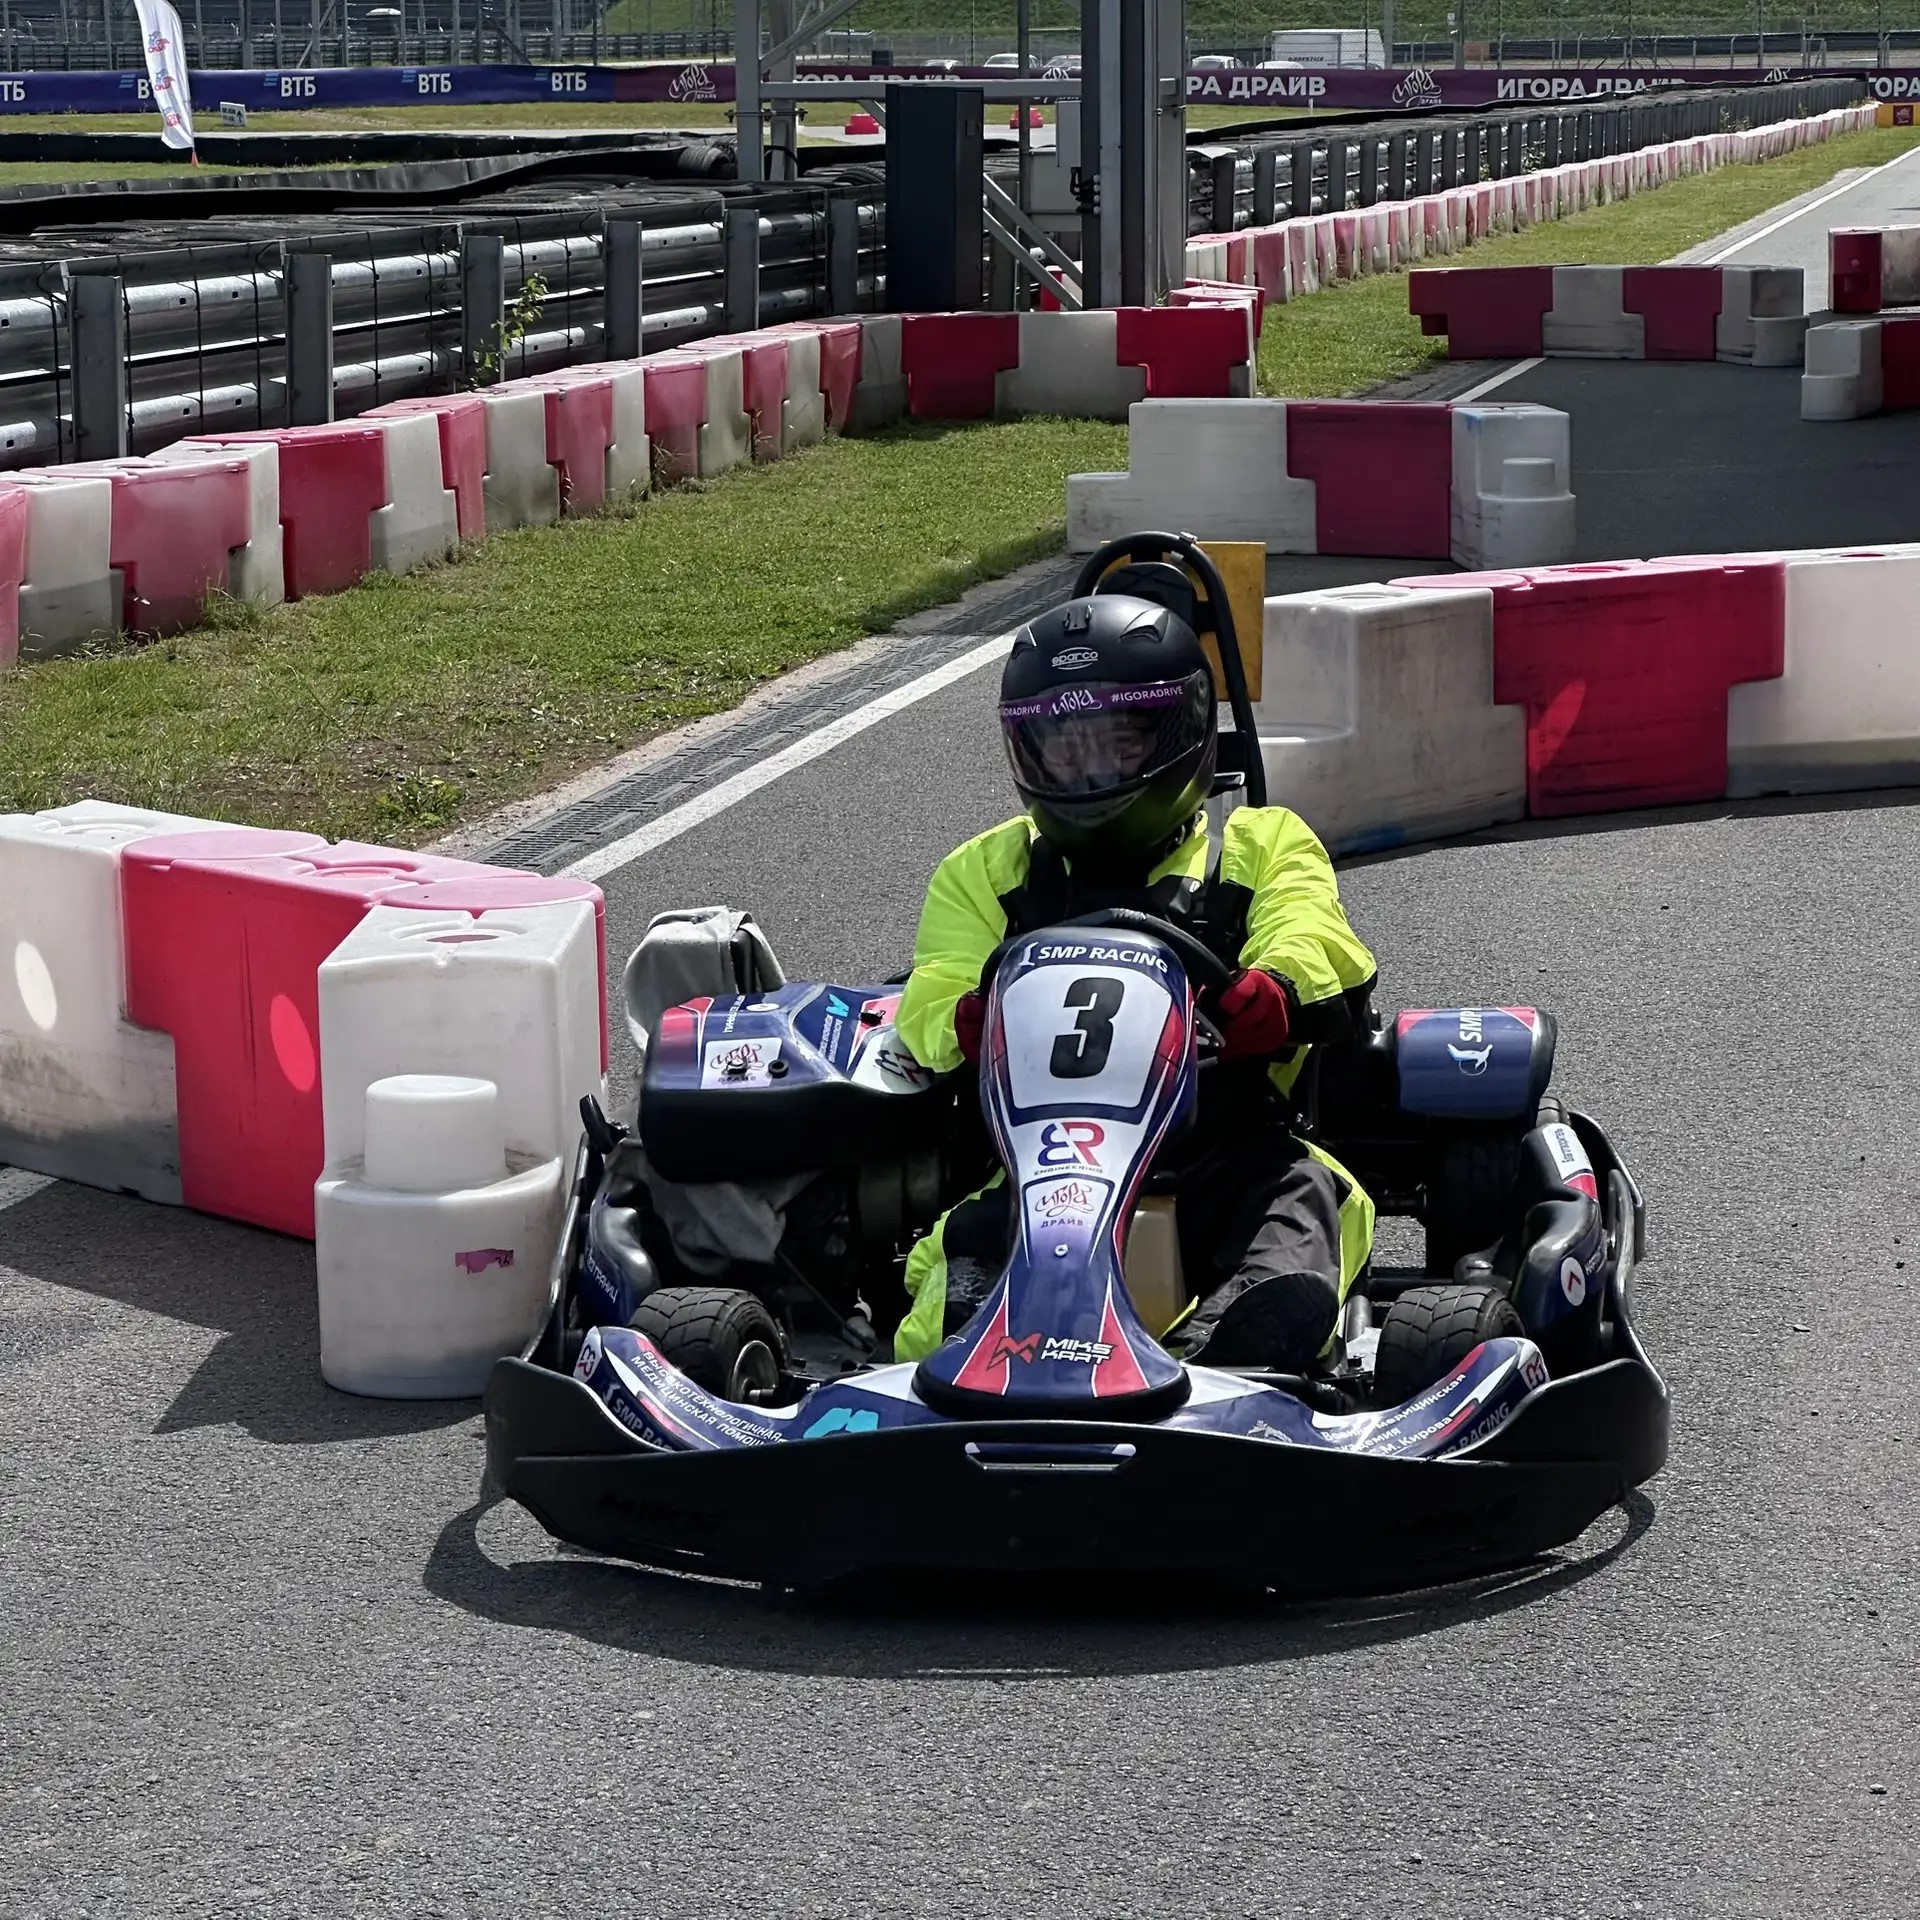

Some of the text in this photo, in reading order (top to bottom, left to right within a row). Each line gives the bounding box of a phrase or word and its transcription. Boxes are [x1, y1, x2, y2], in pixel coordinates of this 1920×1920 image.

[281, 76, 317, 98] ВТБ
[418, 73, 452, 94] ВТБ
[551, 72, 588, 92] ВТБ
[1229, 76, 1326, 99] ДРАЙВ
[1498, 78, 1583, 99] ИГОРА
[1868, 76, 1920, 98] ОРА
[1111, 686, 1184, 703] #IGORADRIVE
[1038, 946, 1169, 974] SMP RACING
[1049, 976, 1126, 1079] 3
[1034, 1164, 1104, 1176] ENGINEERING
[1040, 1217, 1084, 1229] ДРАЙВ
[1045, 1337, 1114, 1354] MIKS
[1041, 1350, 1111, 1365] KART
[630, 1355, 718, 1427] МЕДИЦИНСКАЯ
[612, 1397, 644, 1431] SMP
